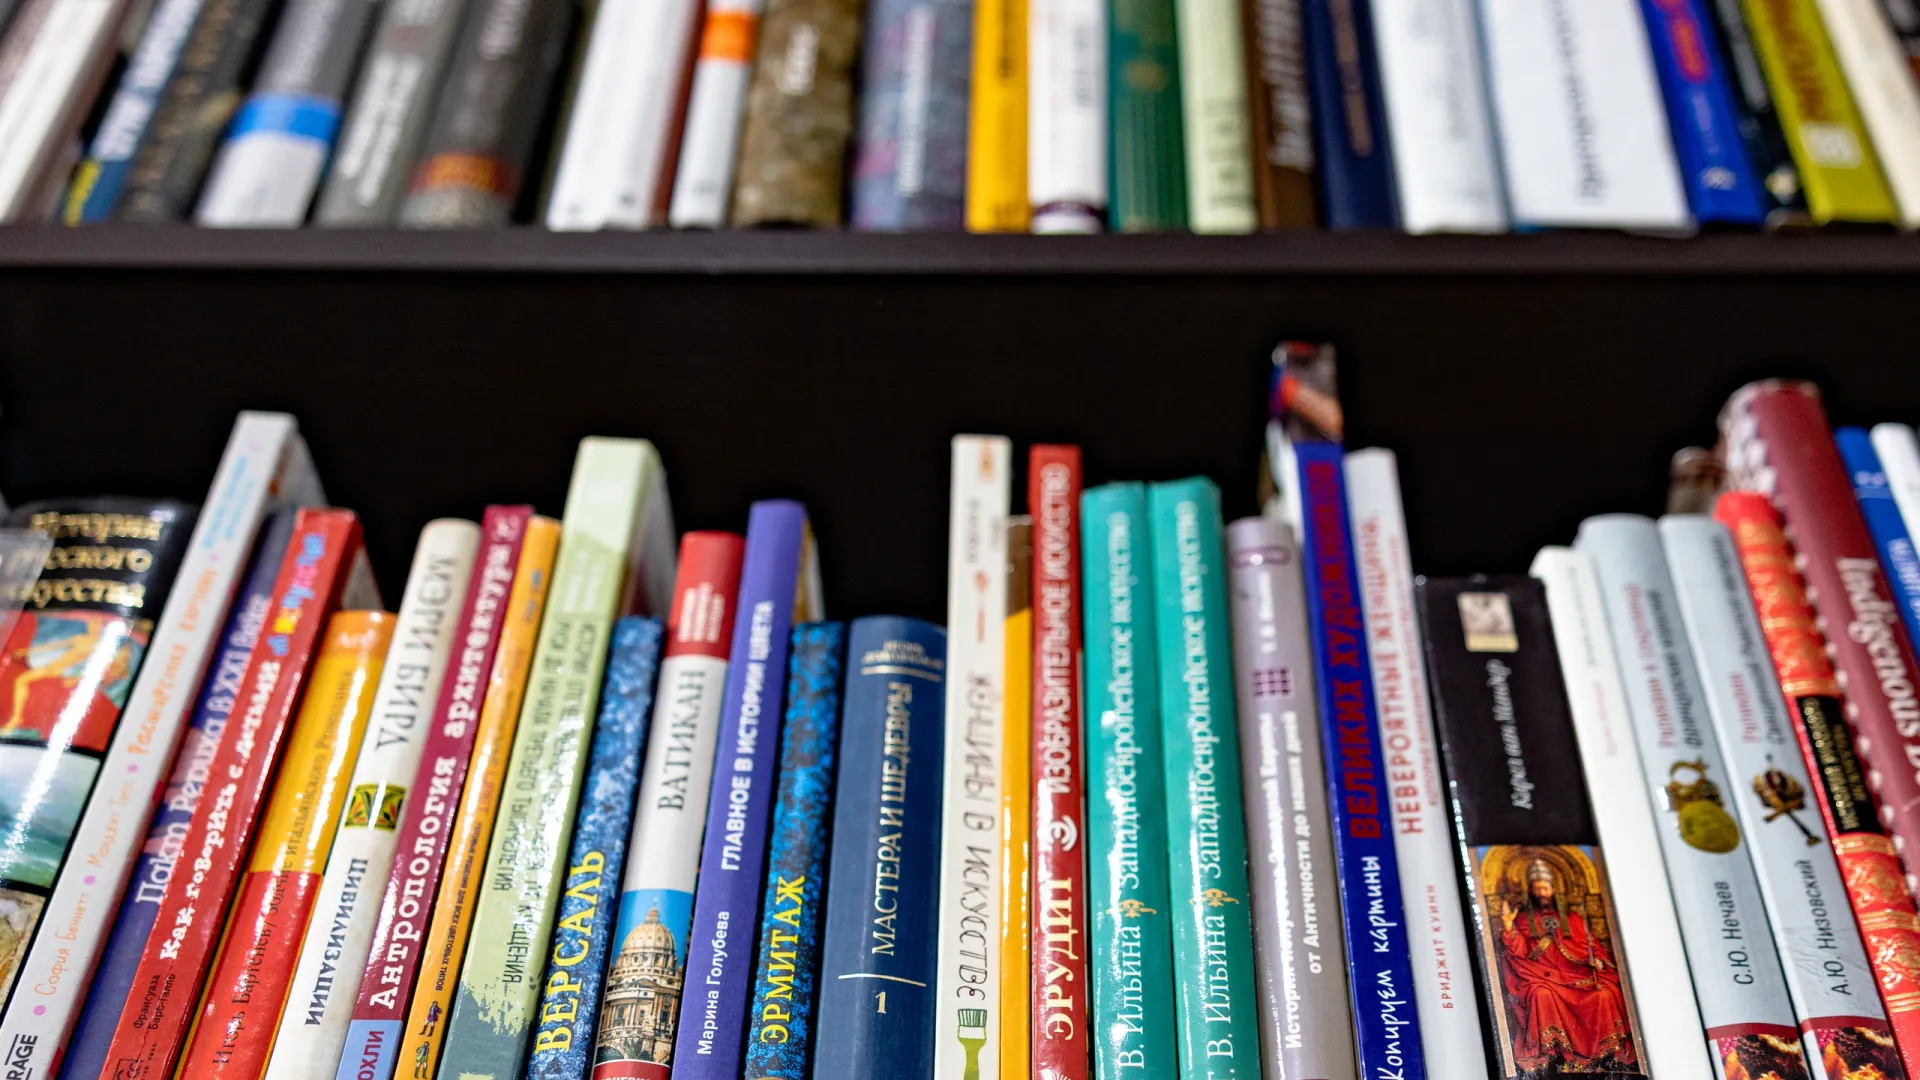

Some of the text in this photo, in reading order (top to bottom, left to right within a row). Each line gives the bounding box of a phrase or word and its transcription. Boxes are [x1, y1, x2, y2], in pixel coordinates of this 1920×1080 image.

[375, 553, 459, 751] МЭРИ БИРД
[1042, 582, 1071, 793] ИЗОБРАЗИТЕЛЬНОЕ
[1836, 557, 1920, 737] Indigenous
[137, 823, 190, 903] Пакт
[215, 650, 252, 691] XXI
[370, 756, 457, 1009] Антропология
[444, 544, 513, 738] архитектуры
[658, 669, 706, 811] ВАТИКАН
[721, 602, 775, 870] ГЛАВНОЕ В ИСТОРИИ ЦВЕТА
[1111, 628, 1142, 889] Западноевропейское
[1184, 614, 1223, 878] Западноевропейское
[1333, 679, 1382, 839] ВЕЛИКИХ
[1375, 652, 1424, 833] НЕВЕРОЯТНЫЕ
[160, 906, 196, 960] Как
[186, 783, 237, 899] говорить
[229, 765, 243, 779] с
[872, 682, 912, 955] МАСТЕРА И ШЕДЕВРЫ
[962, 812, 995, 831] В
[1294, 815, 1311, 836] до
[34, 892, 89, 995] София Беннетт
[305, 859, 368, 1026] ЦИВИЛИЗАЦИИ
[446, 925, 460, 966] ЦВЕТОВЫХ
[454, 905, 464, 924] ВСЕХ
[534, 851, 606, 1055] ВЕРСАЛЬ
[760, 875, 805, 1044] ЭРМИТАЖ
[957, 846, 991, 1000] ИСКУССТВЕ
[1044, 876, 1079, 1040] ЭРУДИТ
[1297, 841, 1319, 946] Античности
[1308, 952, 1322, 973] от
[1425, 885, 1454, 1009] БРИДЖИТ КУИНН
[1720, 880, 1756, 986] С.Ю. Нечаев
[1800, 859, 1838, 950] Низовский
[134, 975, 161, 1028] Франсуаза
[213, 1011, 246, 1064] Игорь
[232, 929, 271, 1006] Бартенев
[436, 966, 448, 991] ТИПОВ
[697, 911, 730, 1054] Марина Голубева
[875, 991, 887, 1014] 1
[1117, 926, 1143, 1033] Ильина
[1199, 915, 1231, 1023] Ильина
[1283, 971, 1304, 1048] История
[1362, 856, 1409, 1080] Копируем картины
[1827, 953, 1852, 996] А.Ю.
[1117, 1044, 1144, 1068] В.
[1206, 1033, 1233, 1058] В.
